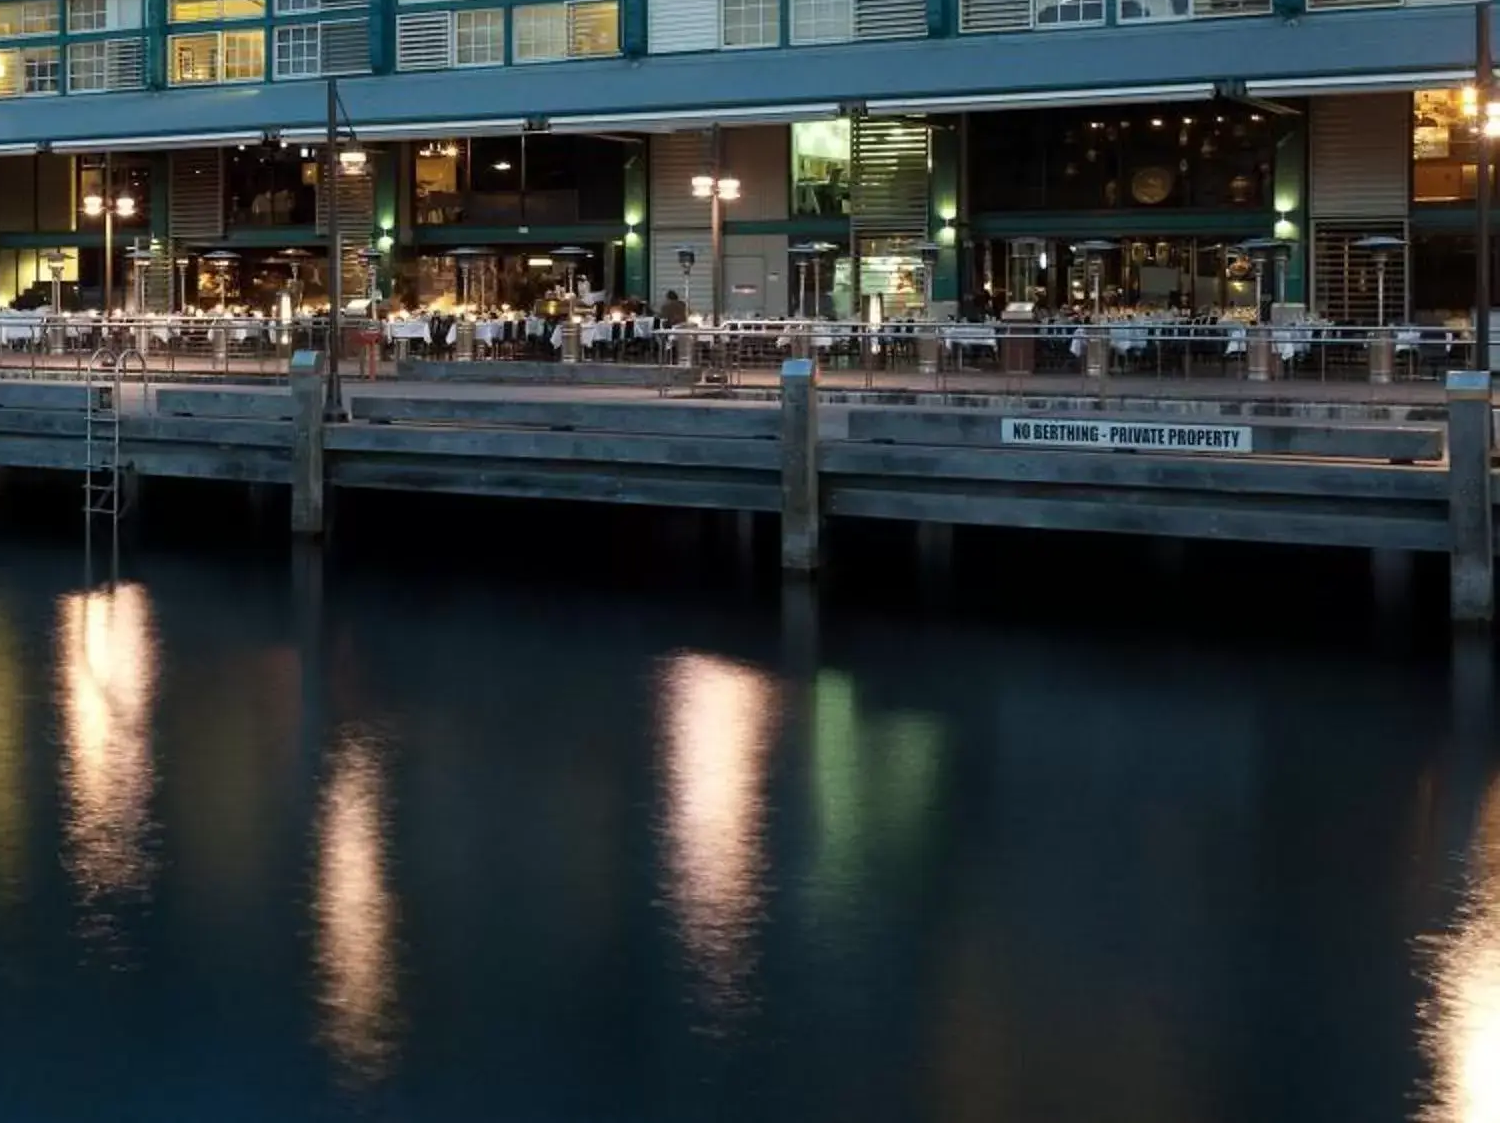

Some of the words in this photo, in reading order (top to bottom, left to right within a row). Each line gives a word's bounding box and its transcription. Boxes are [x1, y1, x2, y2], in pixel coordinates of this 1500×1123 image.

[1013, 422, 1031, 439] NO
[1033, 424, 1099, 442] BERTHING
[1109, 426, 1165, 444] PRIVATE
[1167, 428, 1240, 448] PROPERTY
